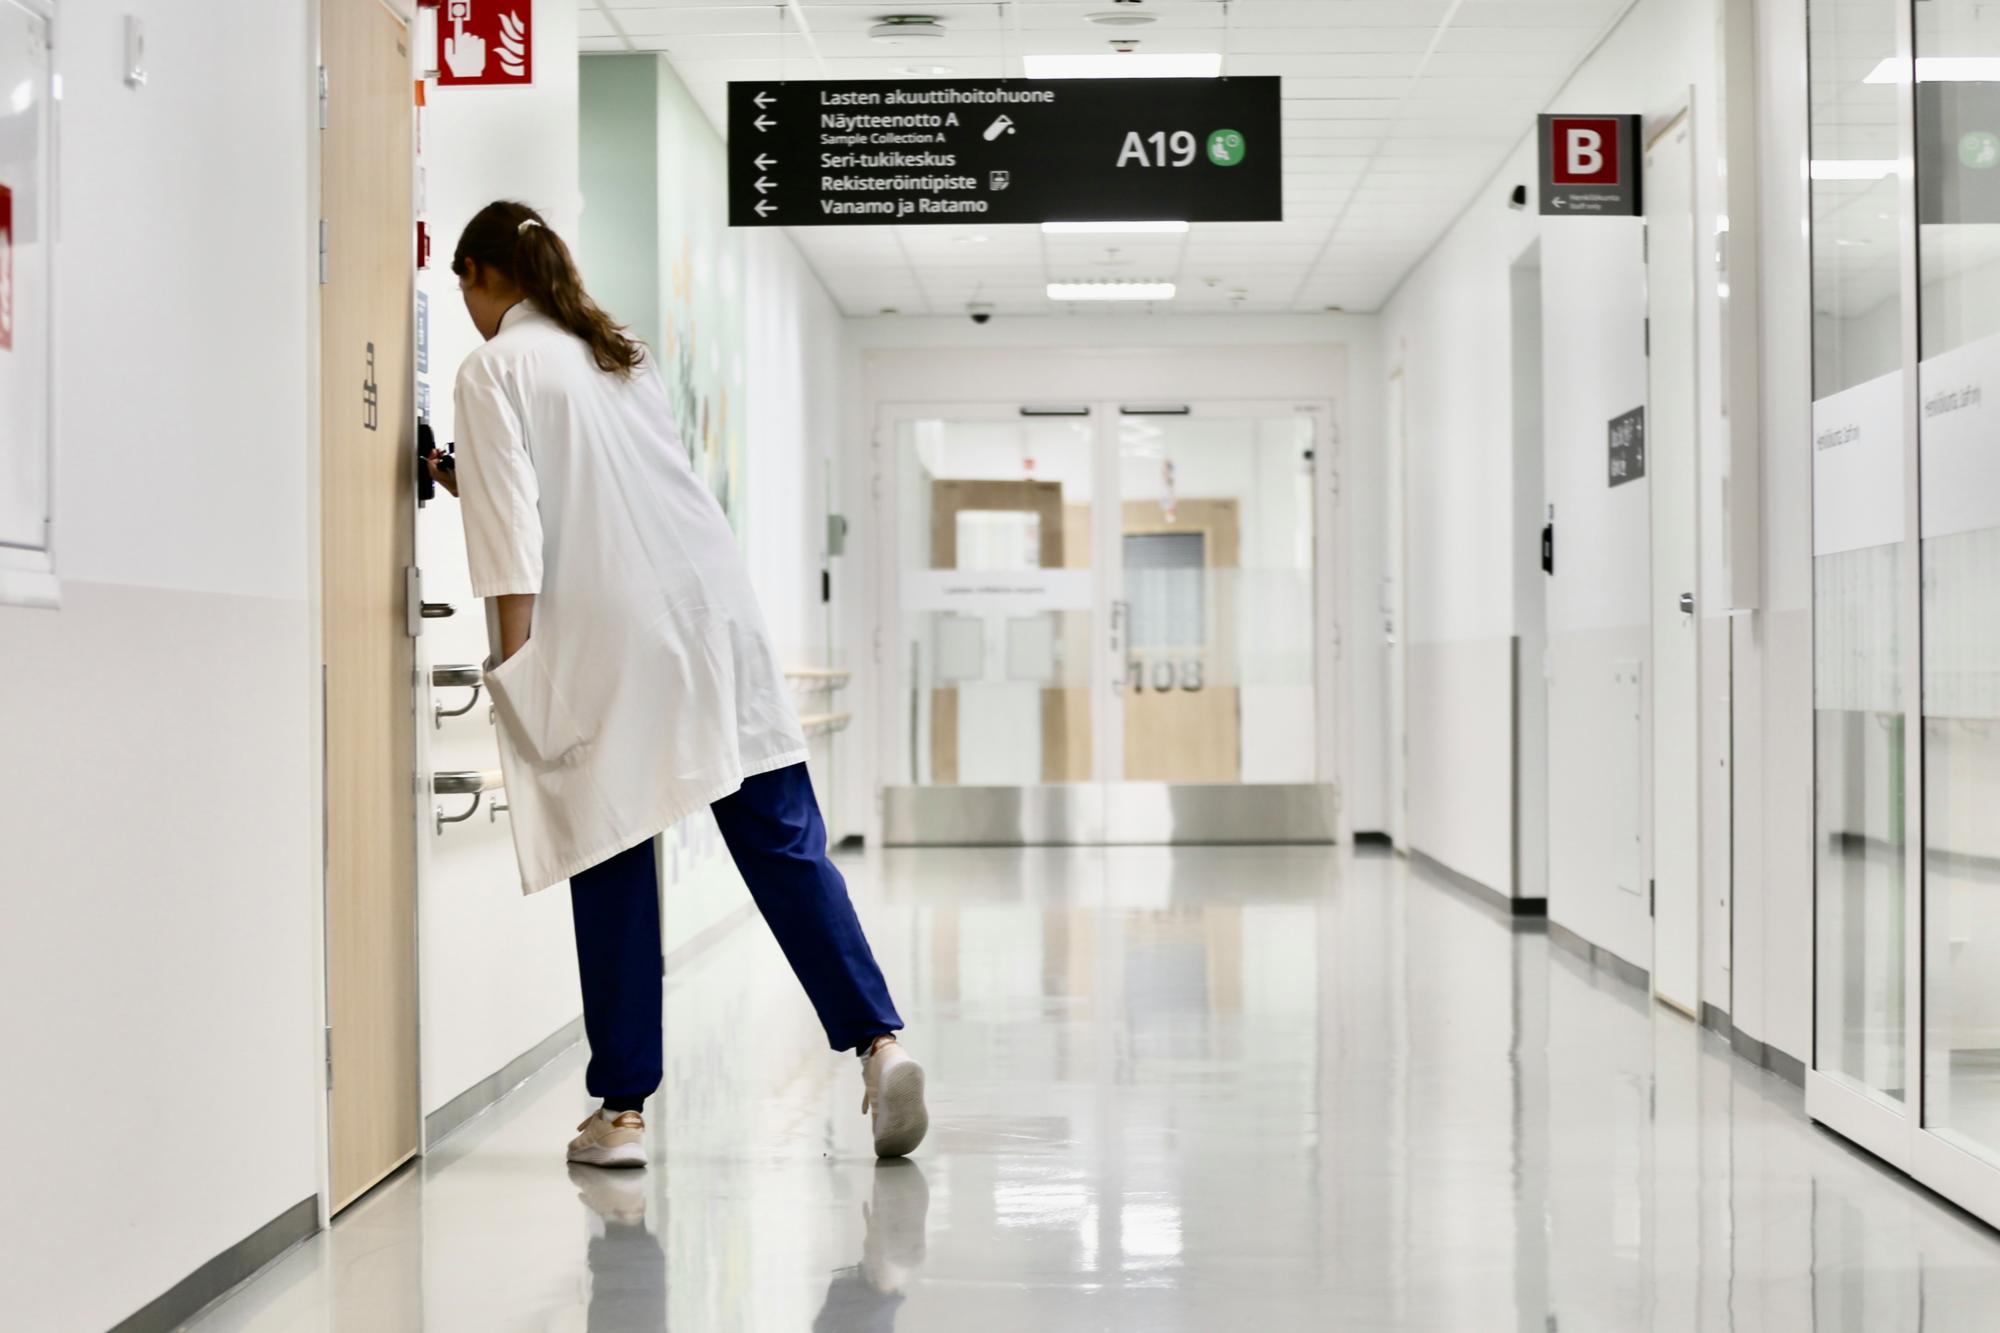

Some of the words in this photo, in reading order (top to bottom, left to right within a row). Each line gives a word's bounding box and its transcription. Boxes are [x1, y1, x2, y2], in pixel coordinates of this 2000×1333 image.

[821, 91, 881, 106] Lasten
[885, 88, 1055, 105] akuuttihoitohuone
[821, 112, 941, 132] Näytteenotto
[945, 112, 960, 127] A
[820, 133, 868, 147] Sample
[870, 132, 933, 144] Collection
[935, 132, 946, 143] A
[1116, 130, 1197, 168] A19
[820, 151, 956, 168] Seri-tukikeskus
[1567, 128, 1603, 175] B
[821, 174, 977, 194] Rekisteröintipiste
[820, 199, 895, 214] Vanamo
[896, 199, 915, 217] ja
[918, 198, 988, 213] Ratamo
